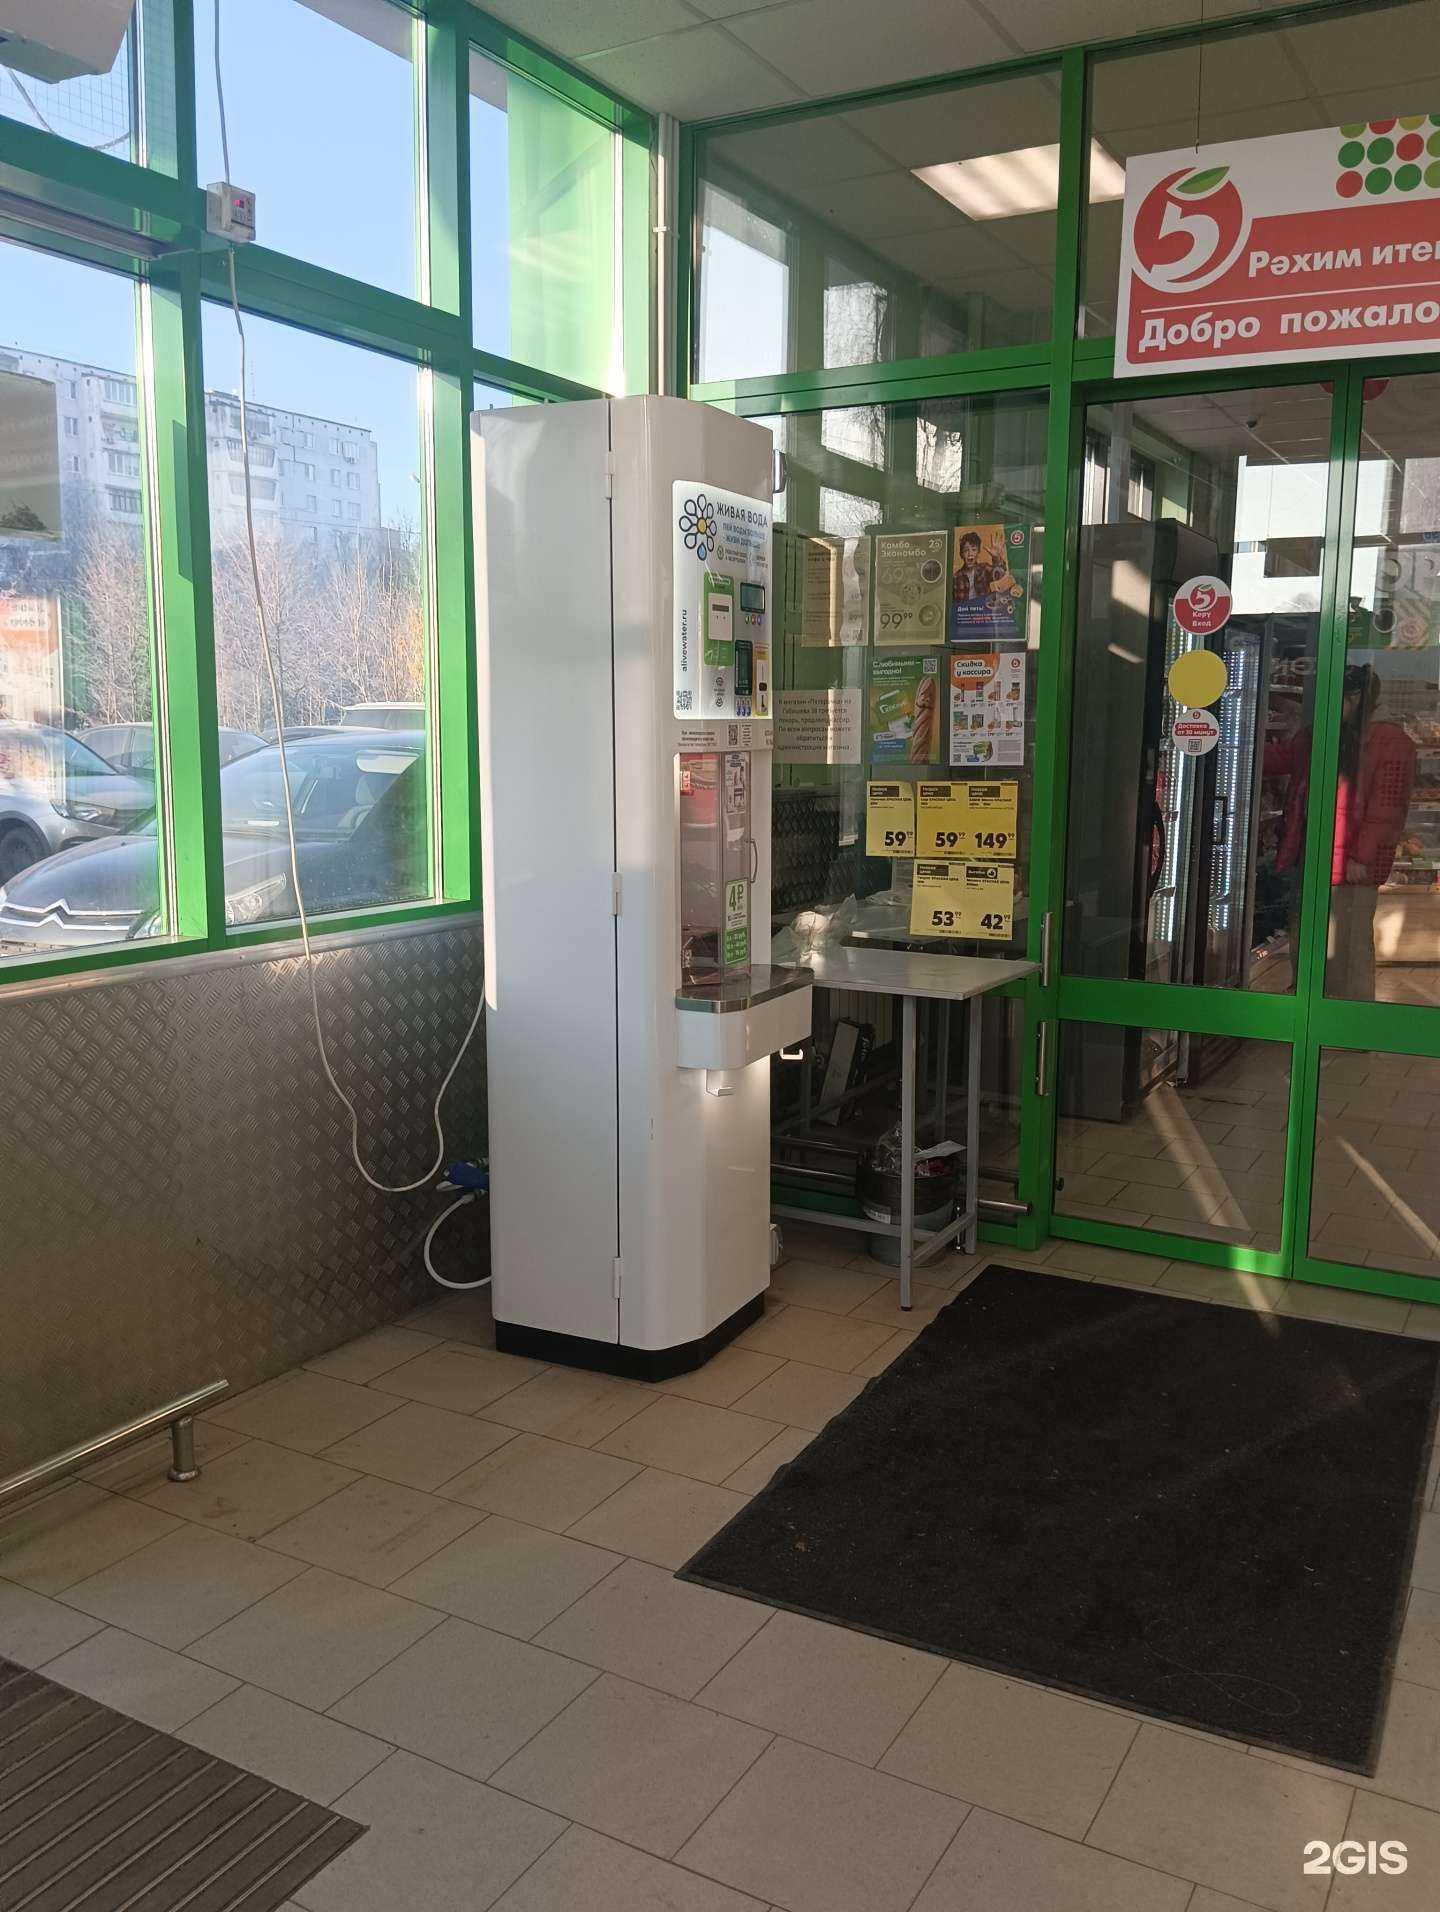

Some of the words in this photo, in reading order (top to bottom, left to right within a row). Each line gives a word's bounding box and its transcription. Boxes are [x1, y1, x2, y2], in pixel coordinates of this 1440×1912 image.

[1248, 248, 1363, 278] Рәхим
[1138, 311, 1261, 353] Добро
[1279, 300, 1440, 335] пожало
[716, 502, 746, 522] ЖИВАЯ
[747, 511, 768, 528] ВОДА
[1192, 611, 1211, 619] Керу
[962, 668, 991, 676] кассира
[1176, 723, 1209, 731] Доставка
[884, 831, 907, 847] 59
[935, 831, 959, 848] 59
[974, 832, 1008, 849] 149
[931, 910, 955, 927] 53
[980, 914, 1004, 930] 42
